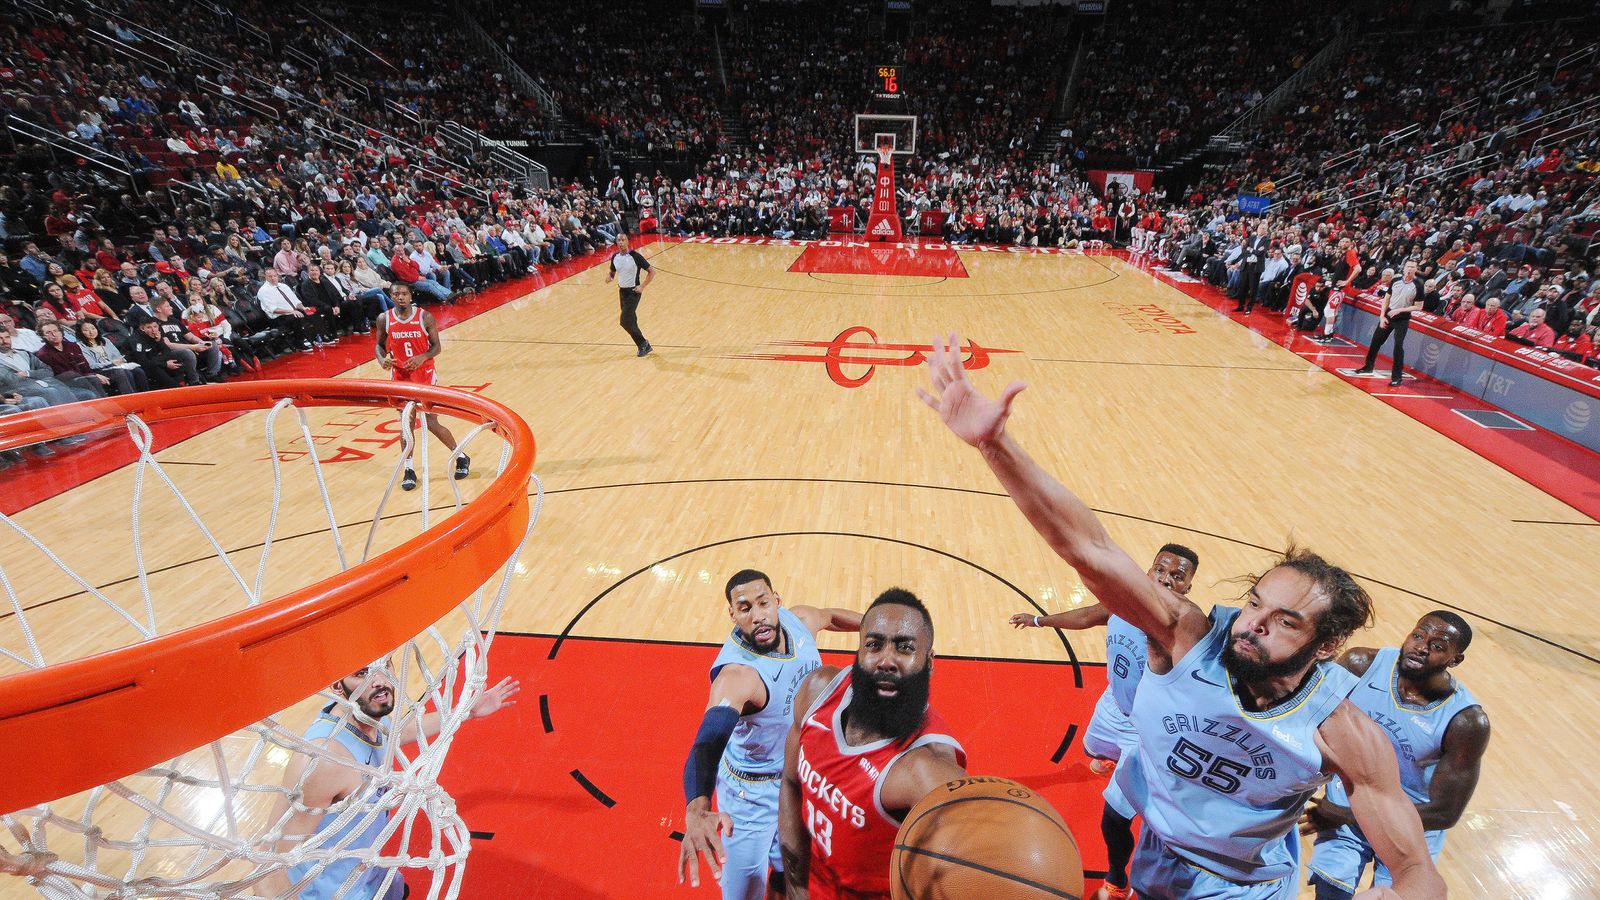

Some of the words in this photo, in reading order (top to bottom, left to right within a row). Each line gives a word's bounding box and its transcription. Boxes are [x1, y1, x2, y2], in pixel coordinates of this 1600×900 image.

[878, 67, 896, 77] 56.0
[885, 77, 898, 93] 16
[871, 228, 895, 236] adidas
[1133, 303, 1197, 335] TOYOTA
[391, 330, 422, 340] ROCKETS
[403, 341, 414, 358] 6
[1476, 368, 1516, 397] AT&T
[1112, 653, 1131, 680] 6
[1162, 713, 1277, 780] GRIZZLIES
[1166, 736, 1253, 794] 55
[797, 744, 866, 828] ROCKETS
[807, 799, 833, 857] 13
